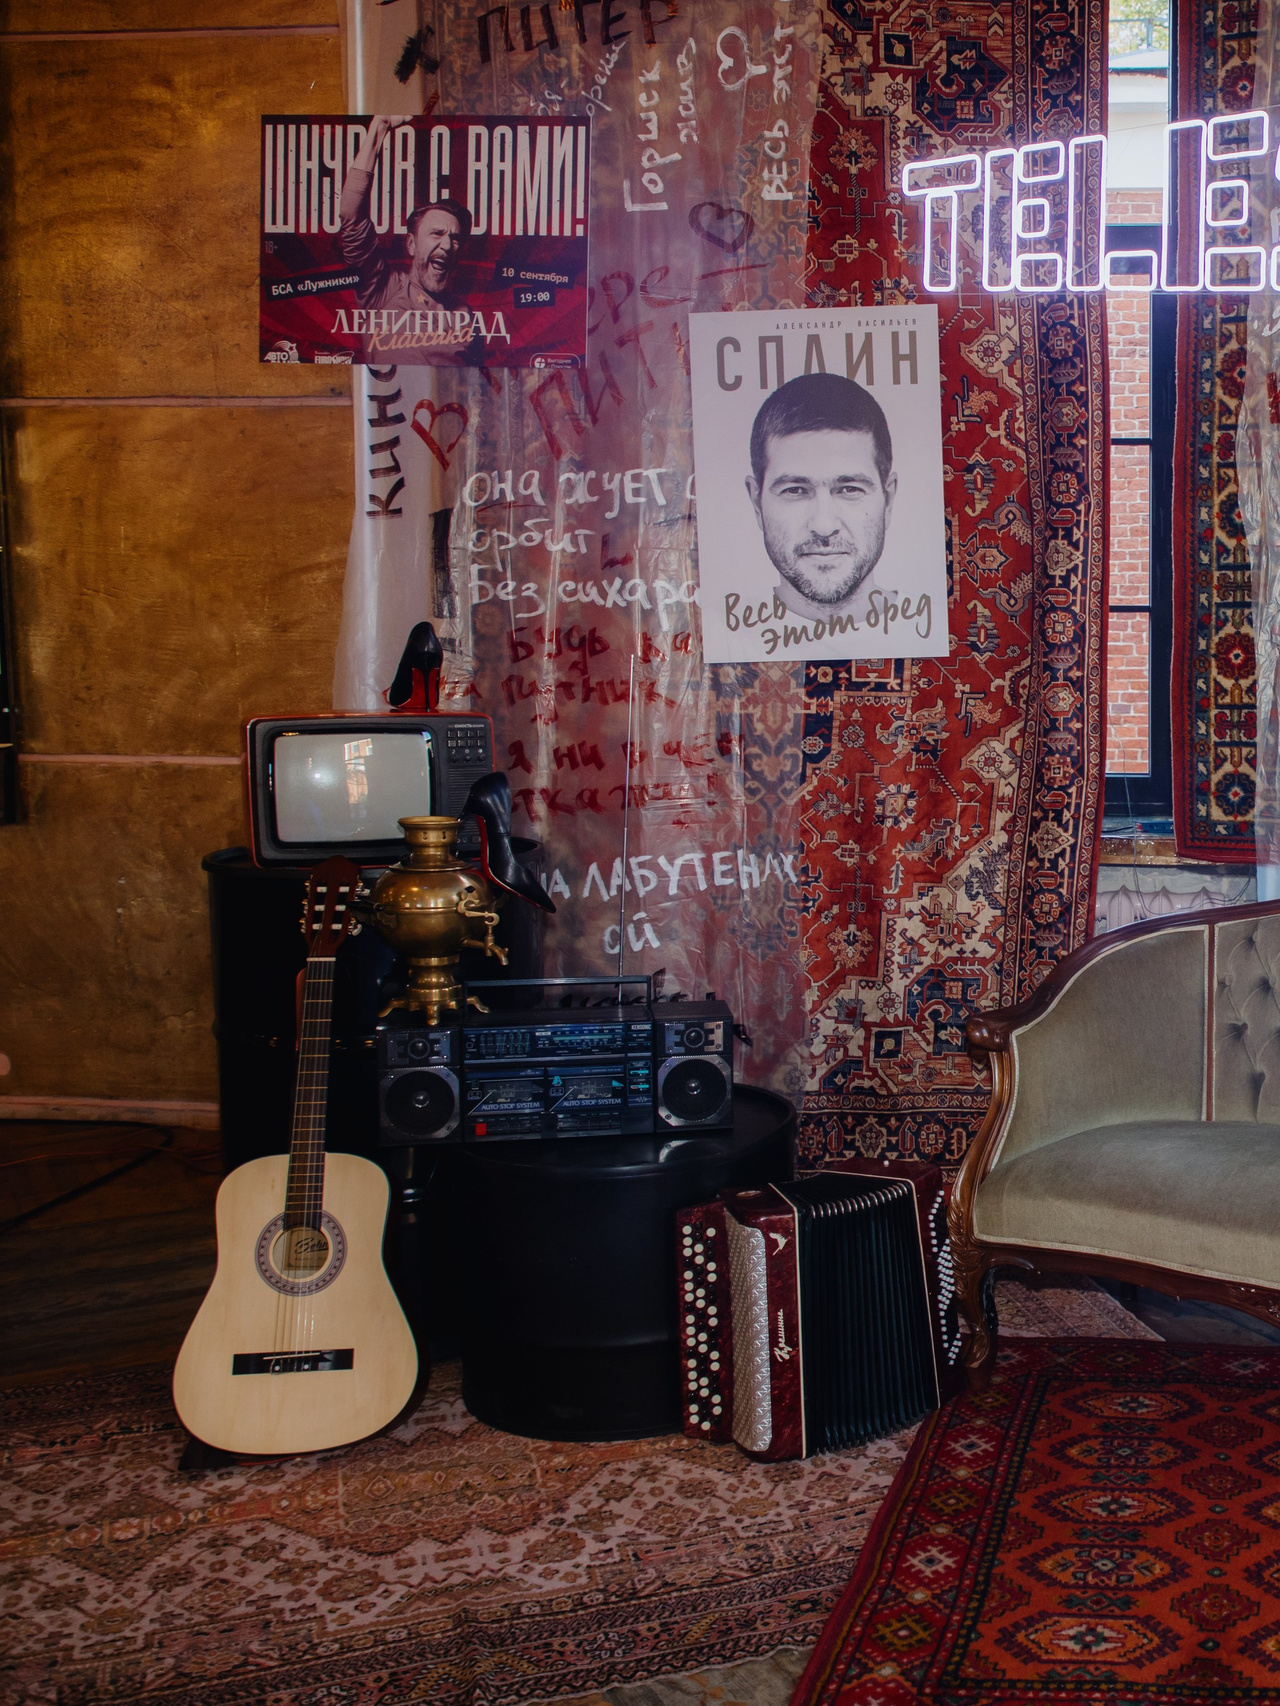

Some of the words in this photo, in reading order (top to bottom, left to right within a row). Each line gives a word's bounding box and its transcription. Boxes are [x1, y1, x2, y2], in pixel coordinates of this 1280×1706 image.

[264, 124, 416, 235] ШНУРОВ
[429, 125, 451, 204] С
[467, 125, 587, 237] ВАМИ!
[271, 283, 294, 296] БСА
[296, 274, 360, 294] «Лужники»
[501, 267, 515, 278] 10
[519, 271, 569, 284] сентября
[519, 291, 551, 303] 19:00
[330, 308, 511, 345] ЛЕНИНГРАД
[775, 321, 843, 331] АЛЕКСАНДР
[857, 318, 918, 328] ВАСИЛЬЕВ
[366, 324, 476, 352] Классика
[715, 330, 919, 392] СПЛИН
[724, 592, 788, 632] Весь
[760, 612, 861, 656] этот
[865, 589, 932, 640] бред
[481, 1103, 499, 1111] AUTO
[500, 1102, 516, 1110] STOP
[516, 1101, 541, 1109] SYSTEM
